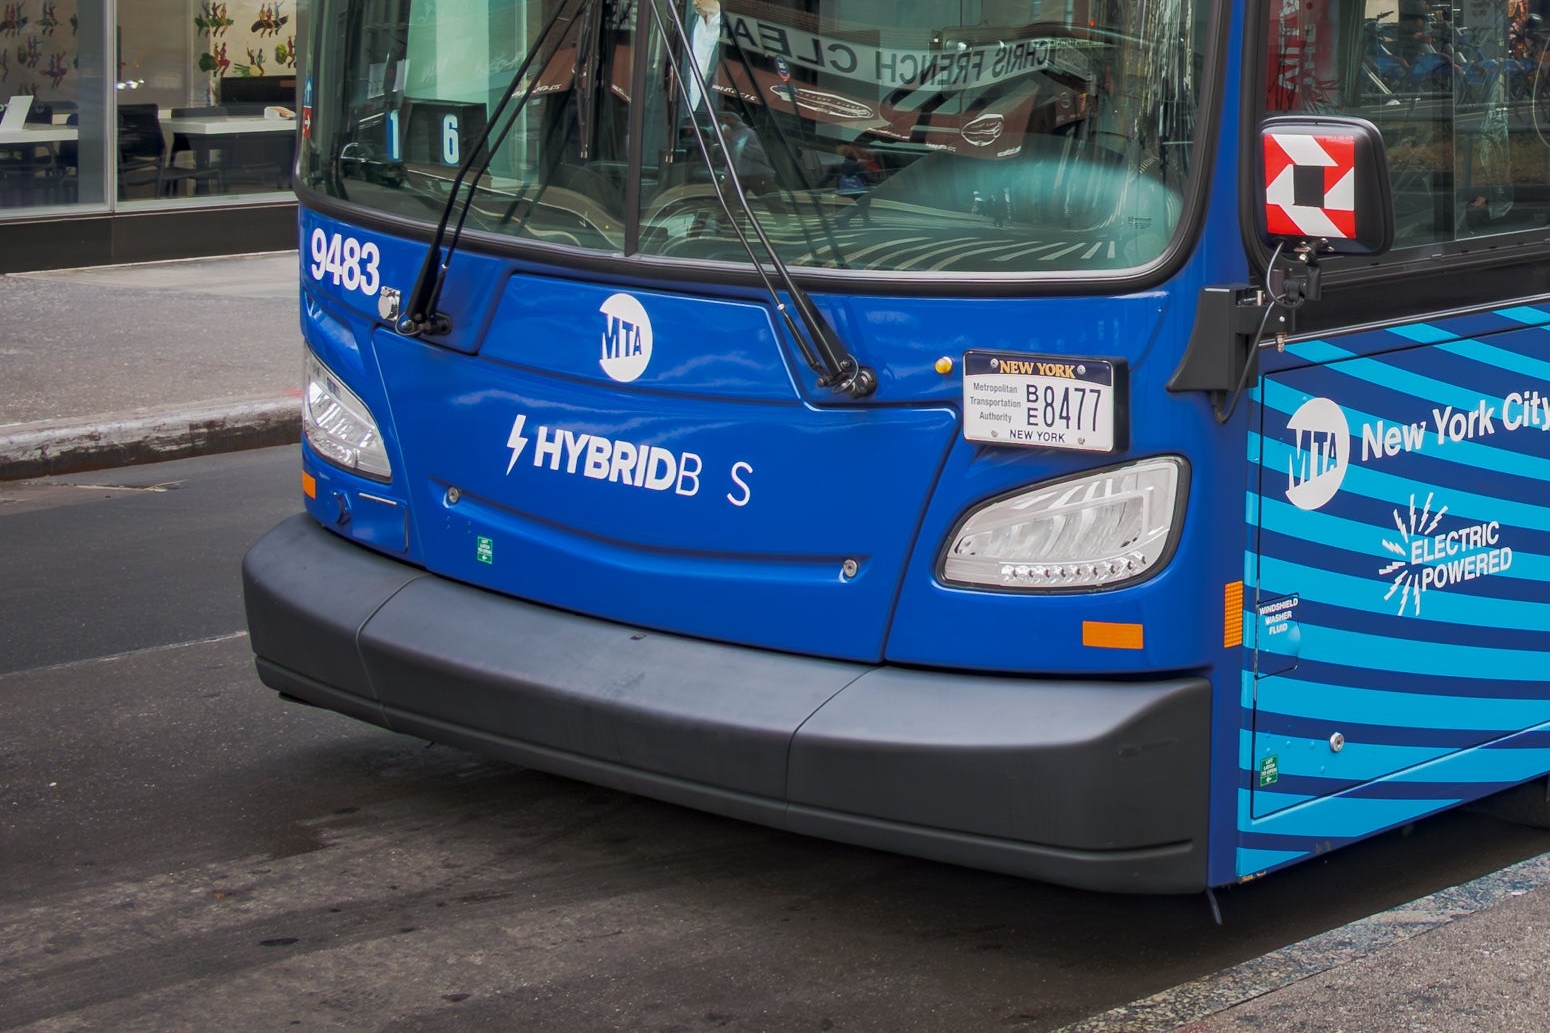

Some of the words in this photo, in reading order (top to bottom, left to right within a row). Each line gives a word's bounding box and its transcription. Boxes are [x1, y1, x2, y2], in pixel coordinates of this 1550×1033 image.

[443, 113, 459, 164] 6
[311, 228, 380, 296] 9483
[1000, 360, 1033, 375] NEW
[1035, 362, 1076, 379] YORK
[973, 382, 1018, 394] Metropolitan
[970, 396, 1021, 408] Transportation
[1043, 386, 1101, 432] 8477
[979, 411, 1012, 423] Authority
[1009, 429, 1036, 441] NEW
[1036, 432, 1065, 443] YORK
[1362, 420, 1426, 462] New
[1432, 399, 1495, 446] York
[1411, 520, 1500, 566] ELECTRIC
[1421, 546, 1513, 592] POWERED
[1259, 597, 1299, 616] WINDSHIELD
[1264, 610, 1293, 626] WASHER
[1268, 622, 1289, 636] FLUID
